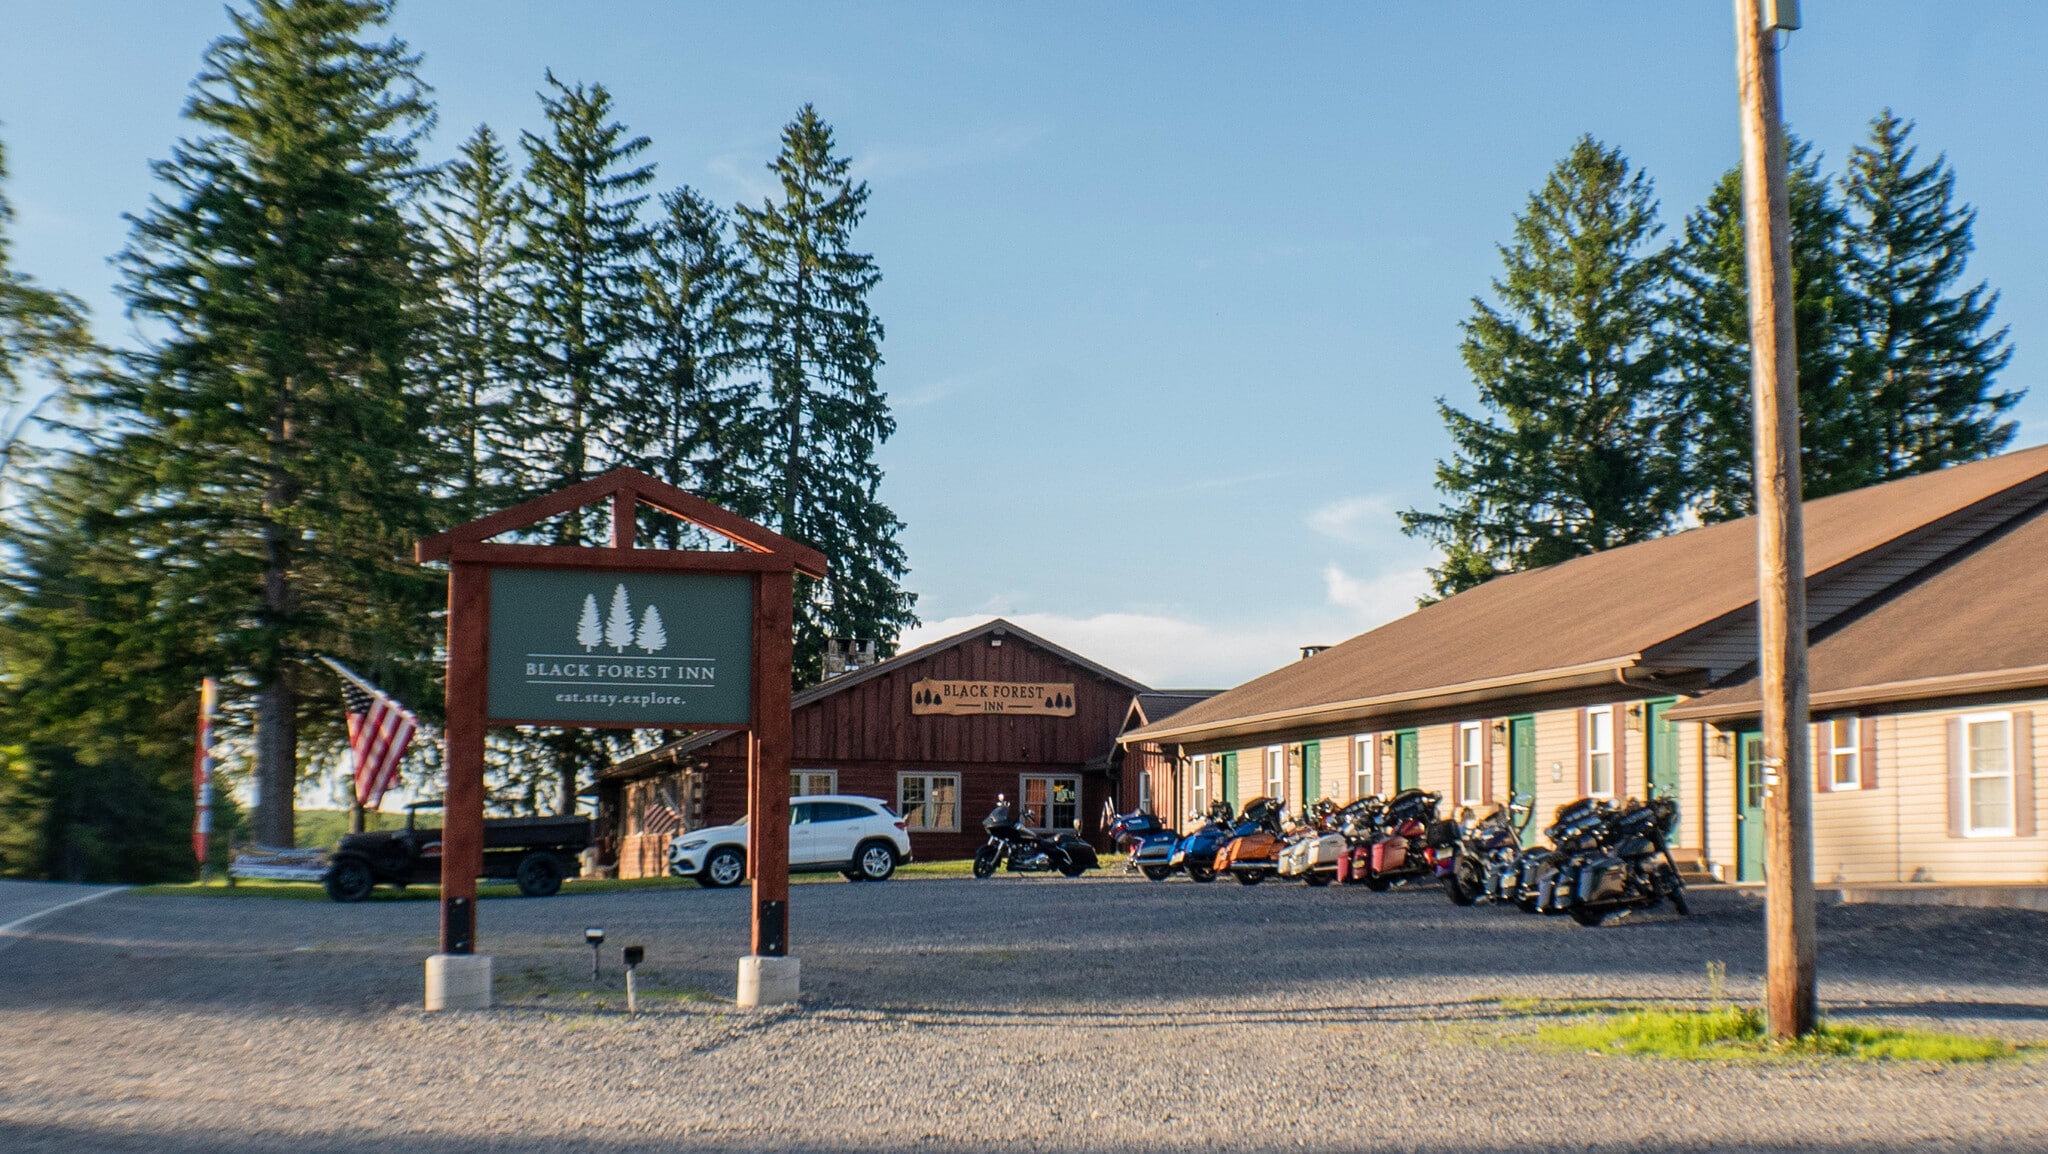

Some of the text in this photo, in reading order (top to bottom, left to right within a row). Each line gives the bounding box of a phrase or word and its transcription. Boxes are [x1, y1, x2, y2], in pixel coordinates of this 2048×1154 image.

[526, 662, 715, 680] BLACK FOREST INN
[944, 684, 1045, 699] BLACK FOREST
[984, 701, 1004, 711] INN
